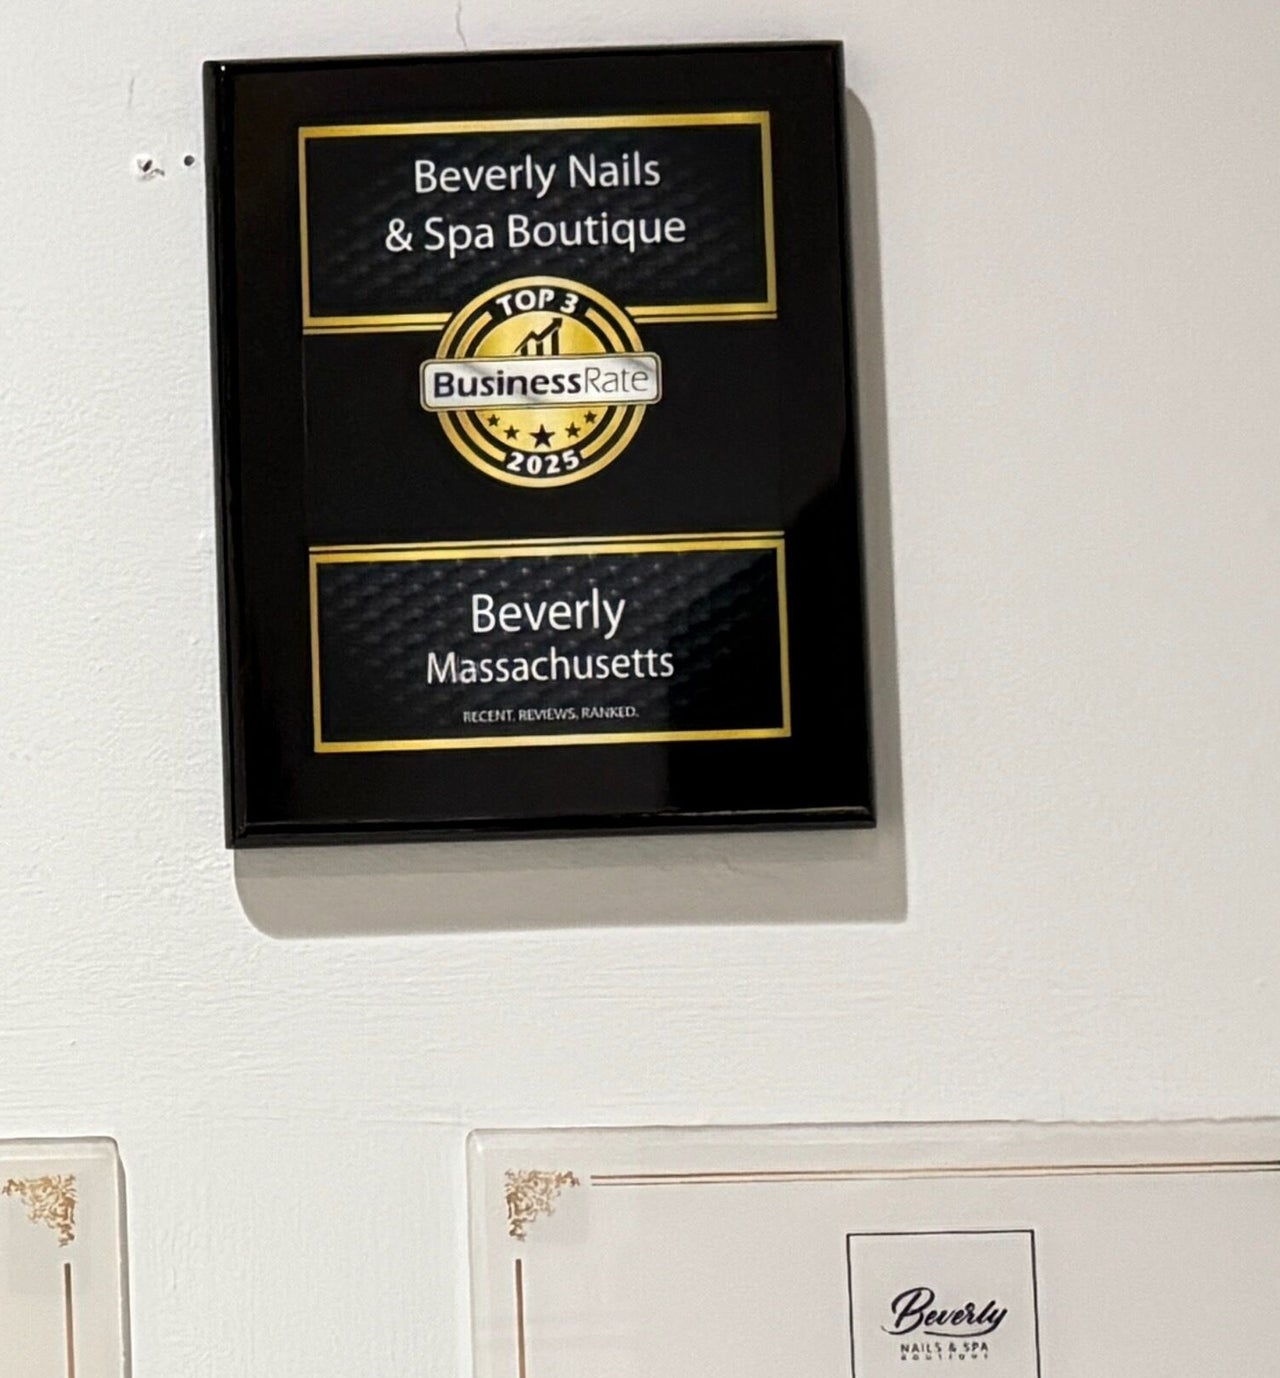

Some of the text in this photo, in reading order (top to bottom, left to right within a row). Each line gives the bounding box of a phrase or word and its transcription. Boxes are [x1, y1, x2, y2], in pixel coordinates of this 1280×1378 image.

[413, 152, 661, 200] Beverly Nails
[385, 211, 687, 258] & Spa Boutique
[496, 288, 579, 317] TOP 3
[434, 367, 650, 398] BusinessRate
[506, 450, 580, 475] 2025
[470, 588, 626, 641] Beverly
[426, 647, 675, 685] Massachusetts
[881, 1286, 1008, 1338] Beverly
[900, 1341, 989, 1353] NAILS & SPA
